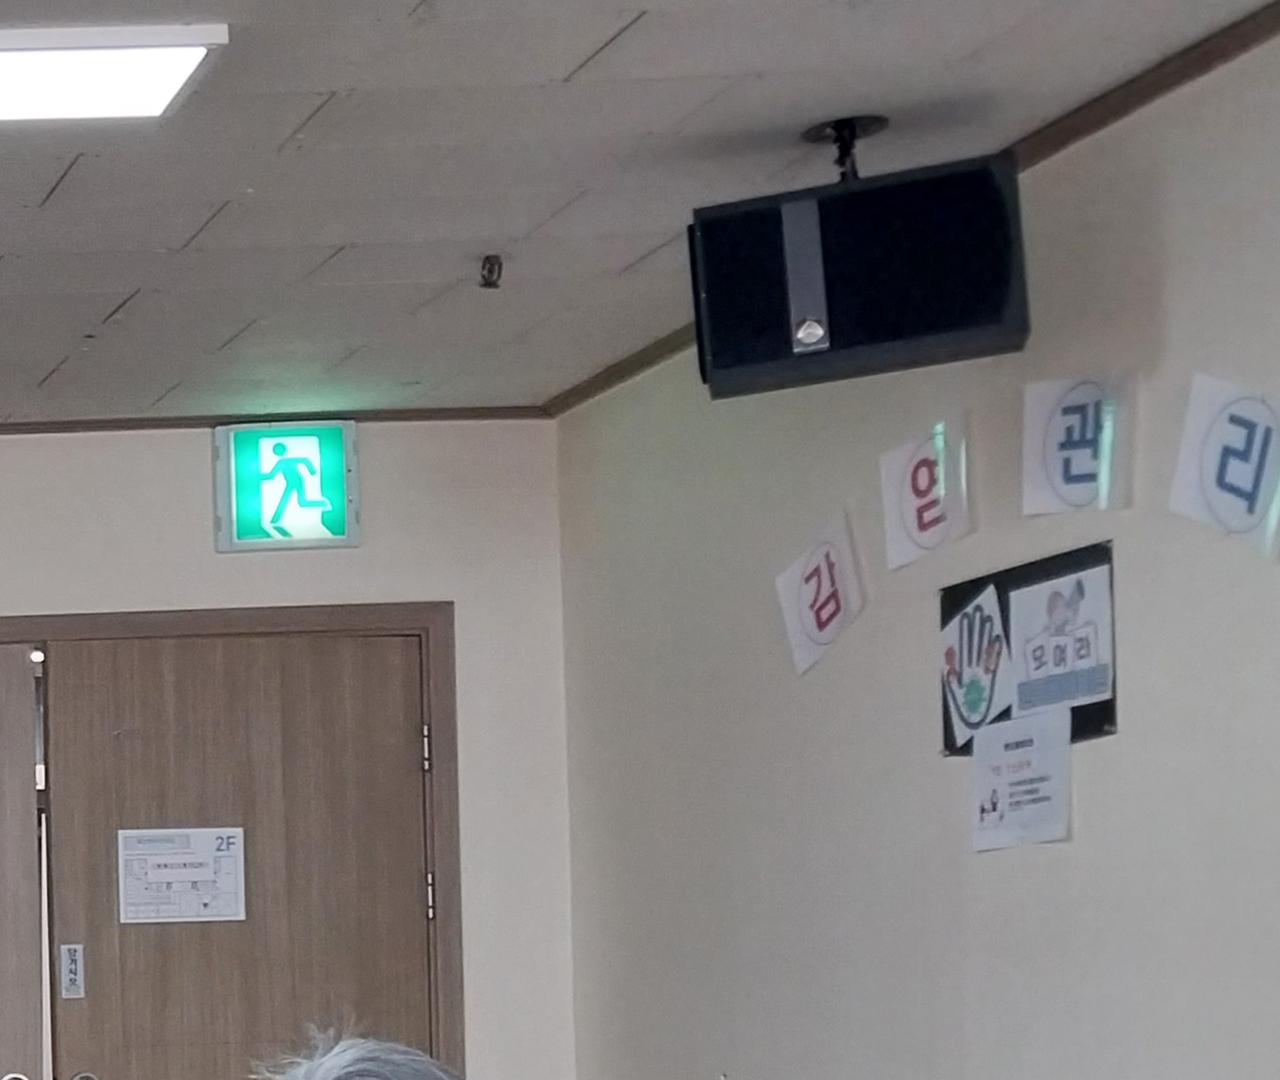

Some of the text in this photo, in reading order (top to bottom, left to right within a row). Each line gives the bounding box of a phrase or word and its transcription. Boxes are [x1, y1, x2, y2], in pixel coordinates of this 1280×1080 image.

[1215, 412, 1273, 515] 리
[803, 551, 843, 633] 감
[214, 835, 237, 852] 2F
